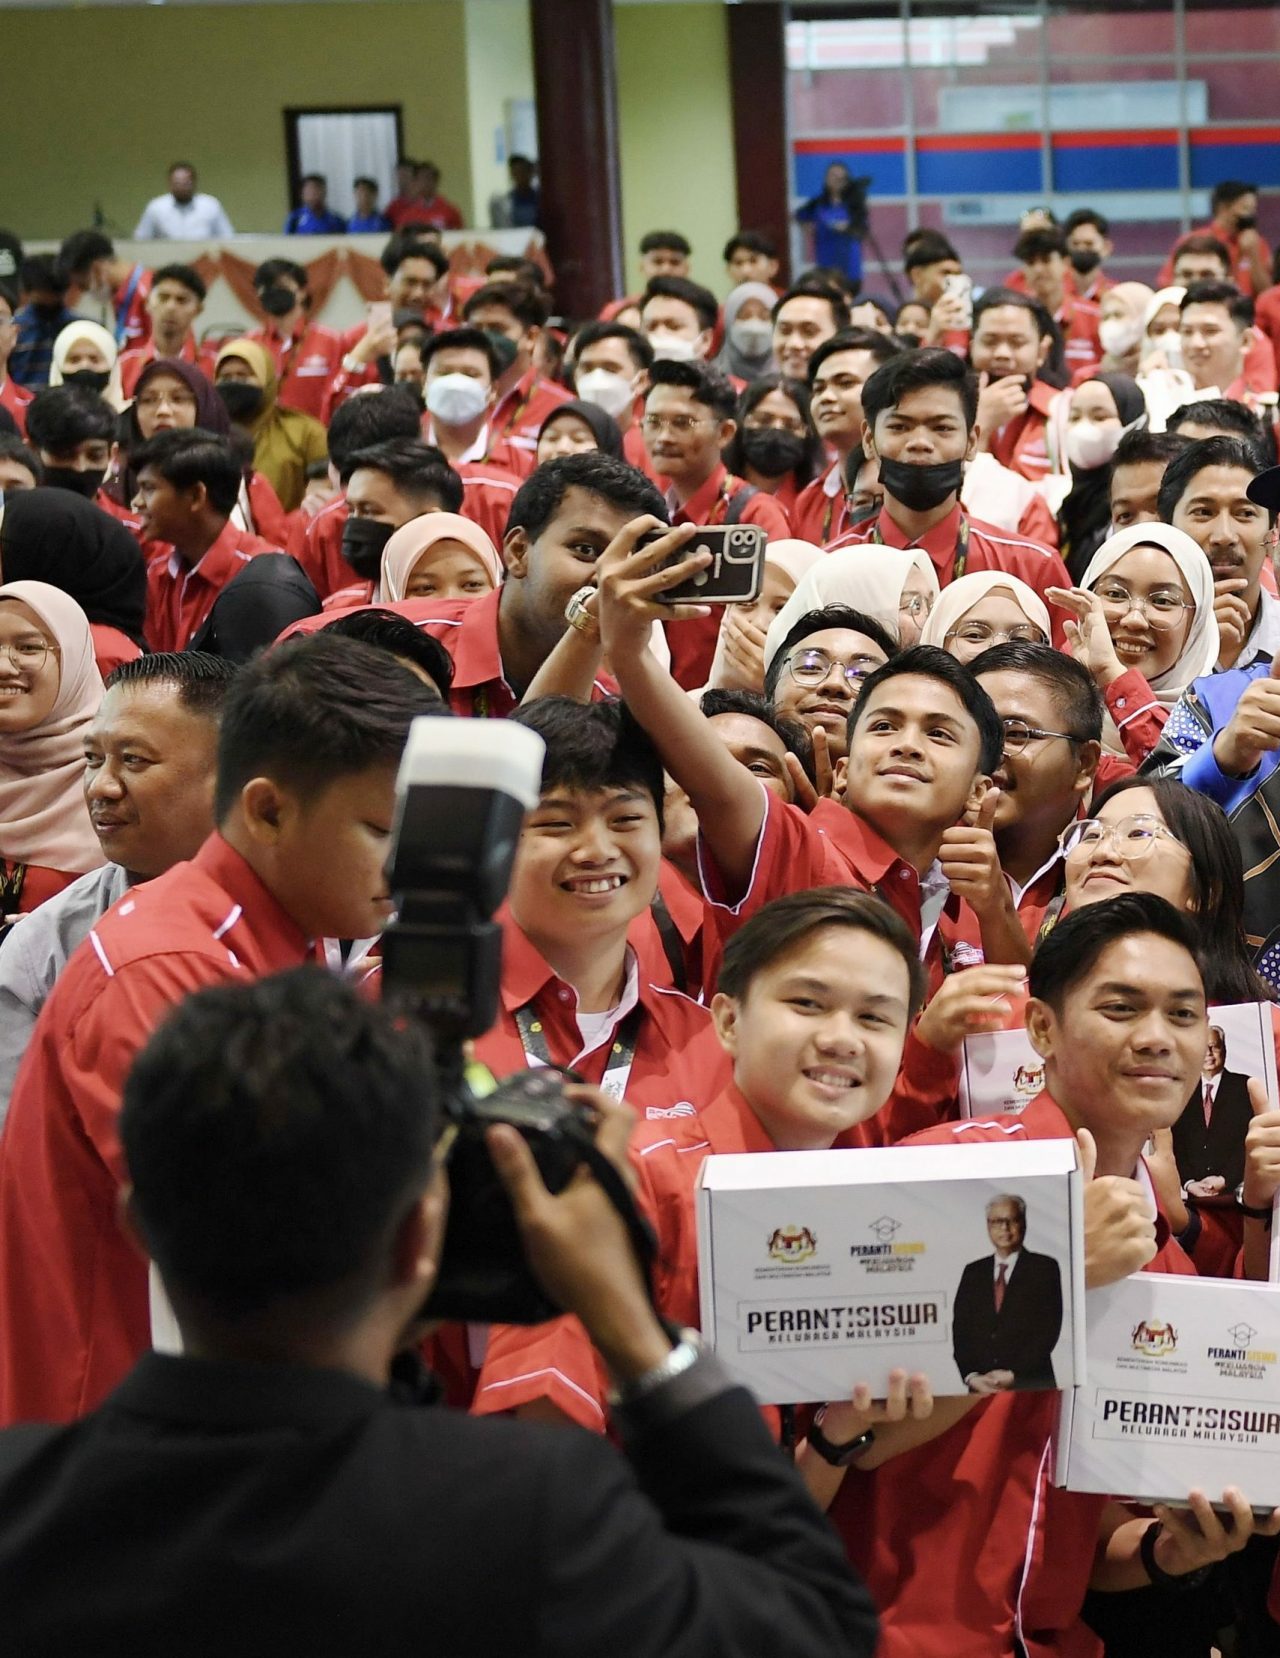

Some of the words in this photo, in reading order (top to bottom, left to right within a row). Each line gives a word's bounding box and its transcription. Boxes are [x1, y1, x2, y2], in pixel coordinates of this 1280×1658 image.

[850, 1242, 926, 1257] PERANTI
[747, 1302, 938, 1333] PERANTISISWA
[768, 1330, 839, 1343] KELUARGA
[846, 1327, 916, 1339] MALAYSIA
[1103, 1400, 1280, 1435] PERANTISISWA
[1121, 1424, 1187, 1439] KELUARGA
[1193, 1431, 1258, 1444] MALAYSIA
